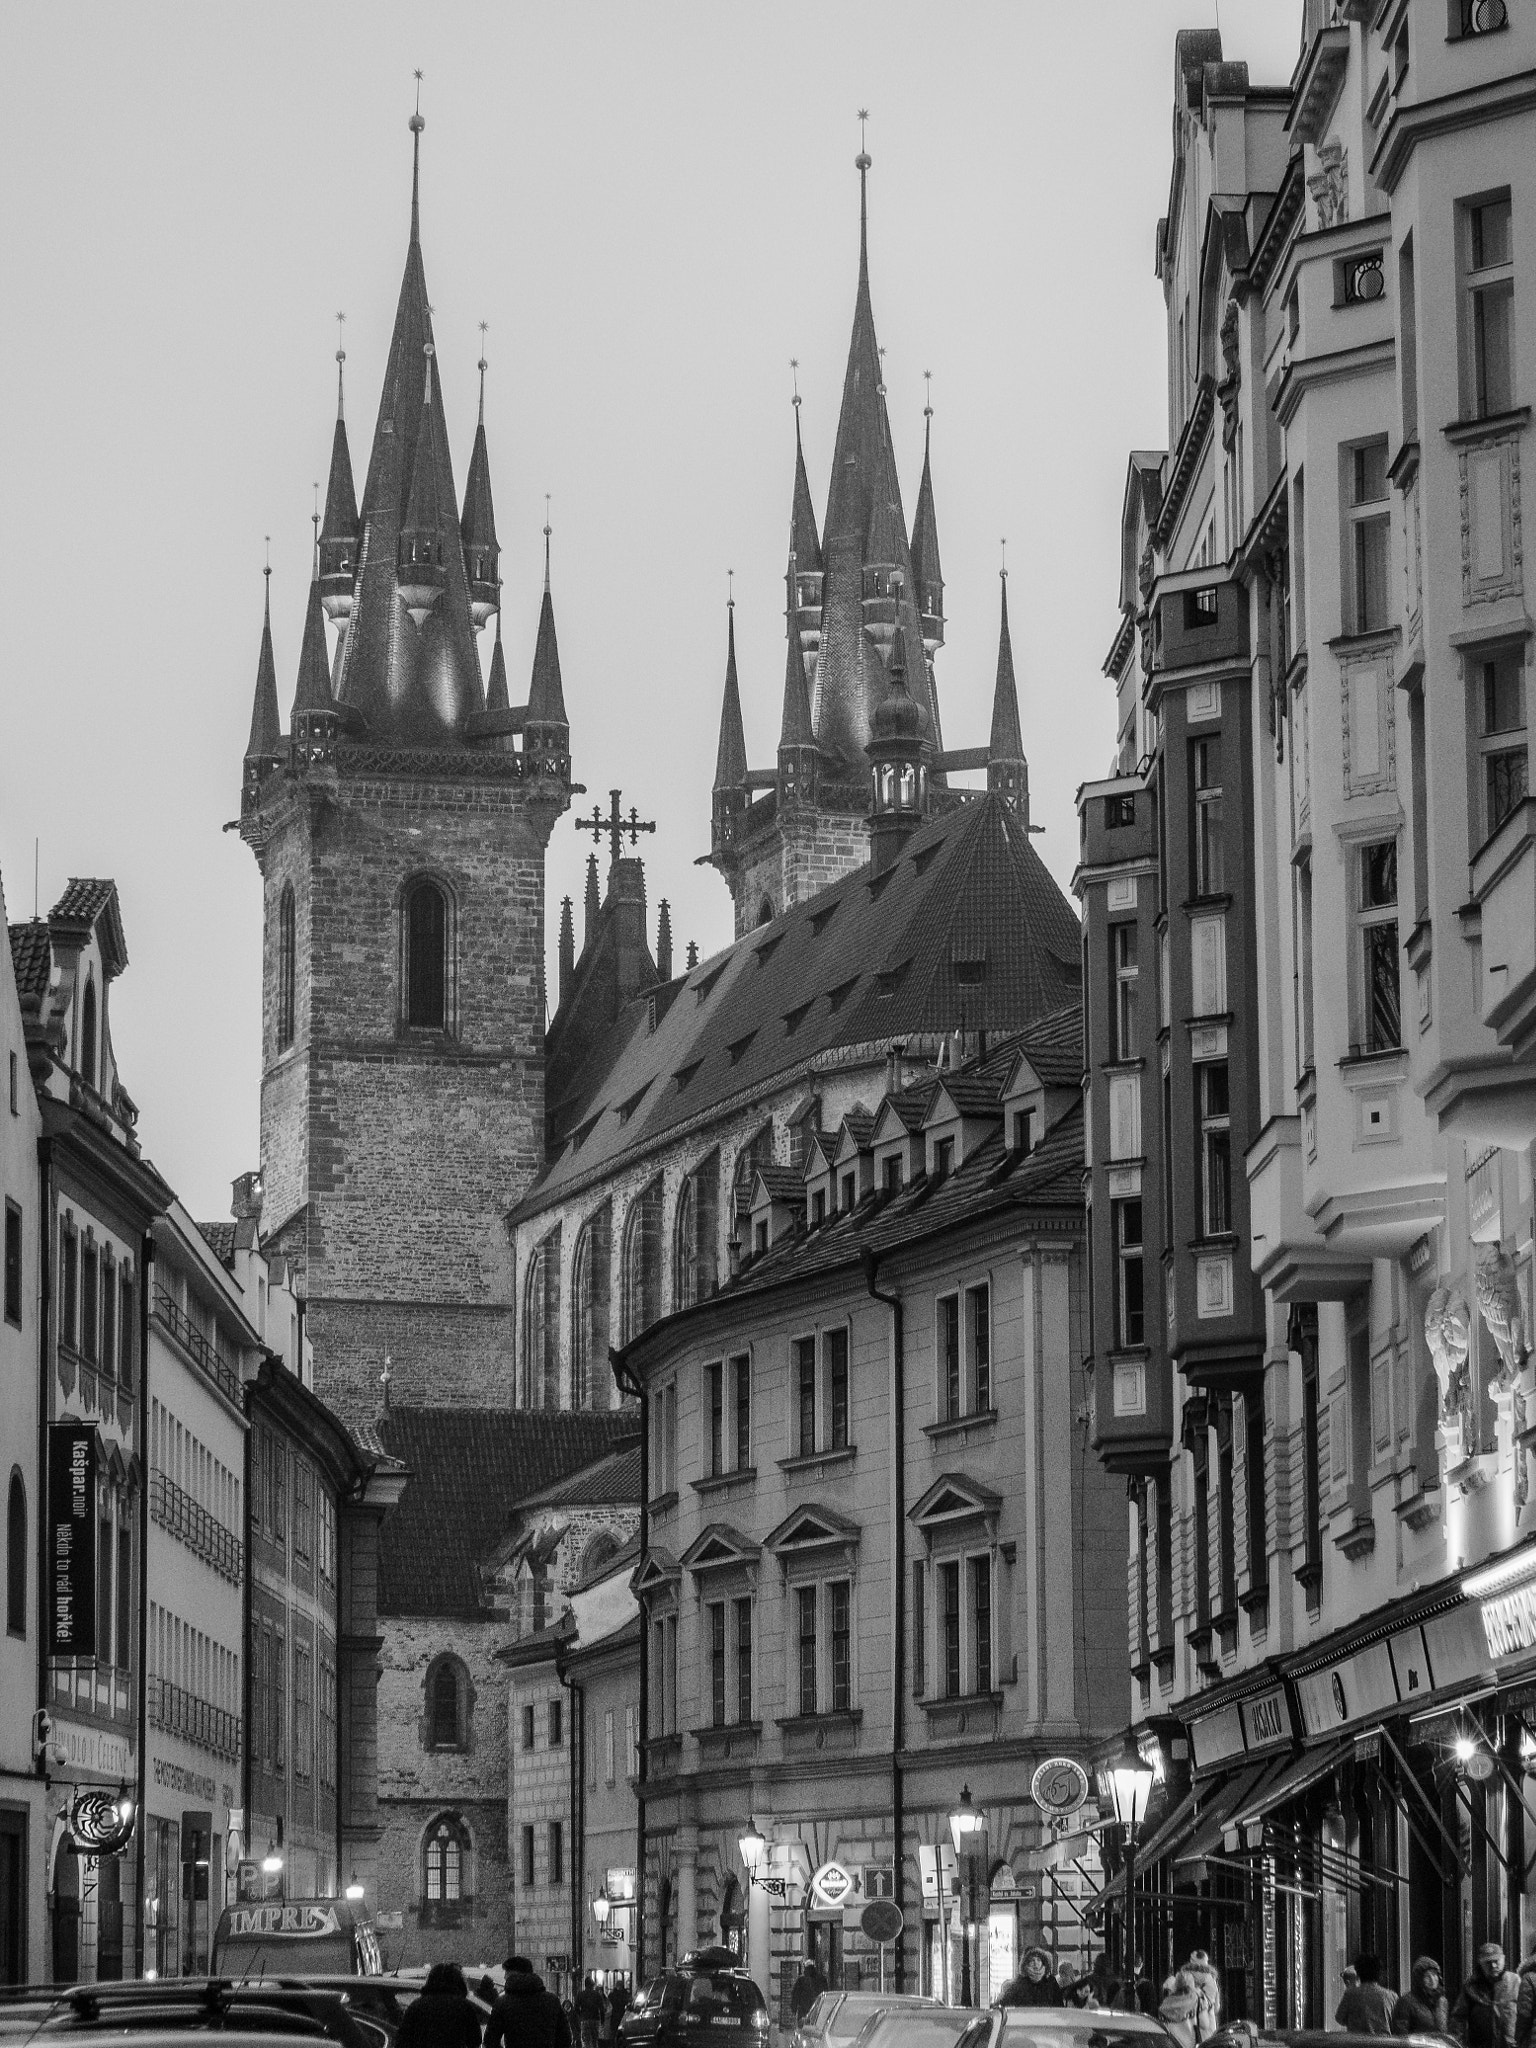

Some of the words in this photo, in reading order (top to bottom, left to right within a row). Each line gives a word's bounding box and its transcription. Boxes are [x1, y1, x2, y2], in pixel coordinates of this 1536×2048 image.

[70, 1440, 89, 1518] Kašpar.noir
[56, 1523, 72, 1555] Někdo
[56, 1558, 72, 1571] to
[56, 1574, 72, 1593] rád
[56, 1596, 73, 1643] hořké!
[229, 1906, 342, 1937] IMPRESA
